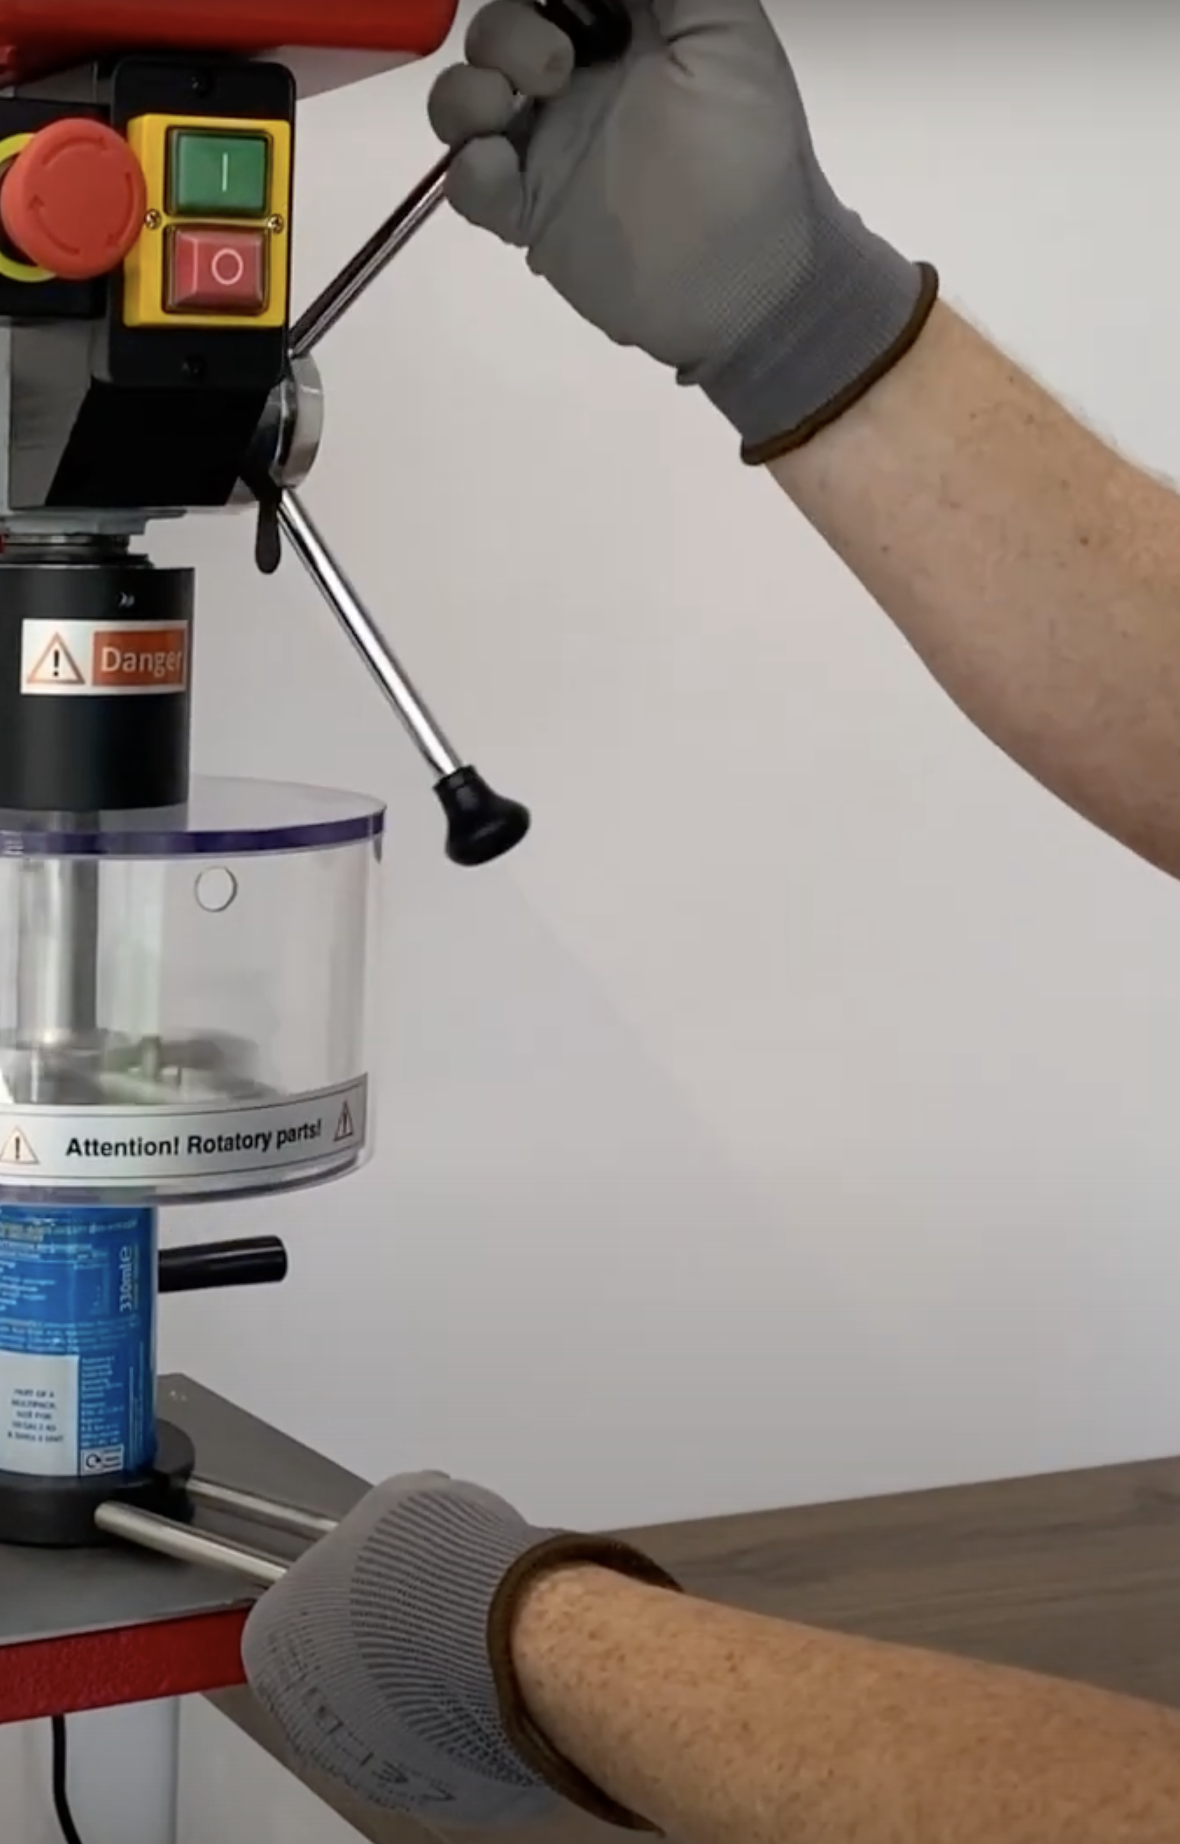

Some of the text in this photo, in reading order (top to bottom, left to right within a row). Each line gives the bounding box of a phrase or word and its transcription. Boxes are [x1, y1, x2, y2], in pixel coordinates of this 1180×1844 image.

[101, 646, 183, 679] Danger
[65, 1117, 323, 1158] Attention! Rotatory parts!
[119, 1263, 133, 1313] 330ml
